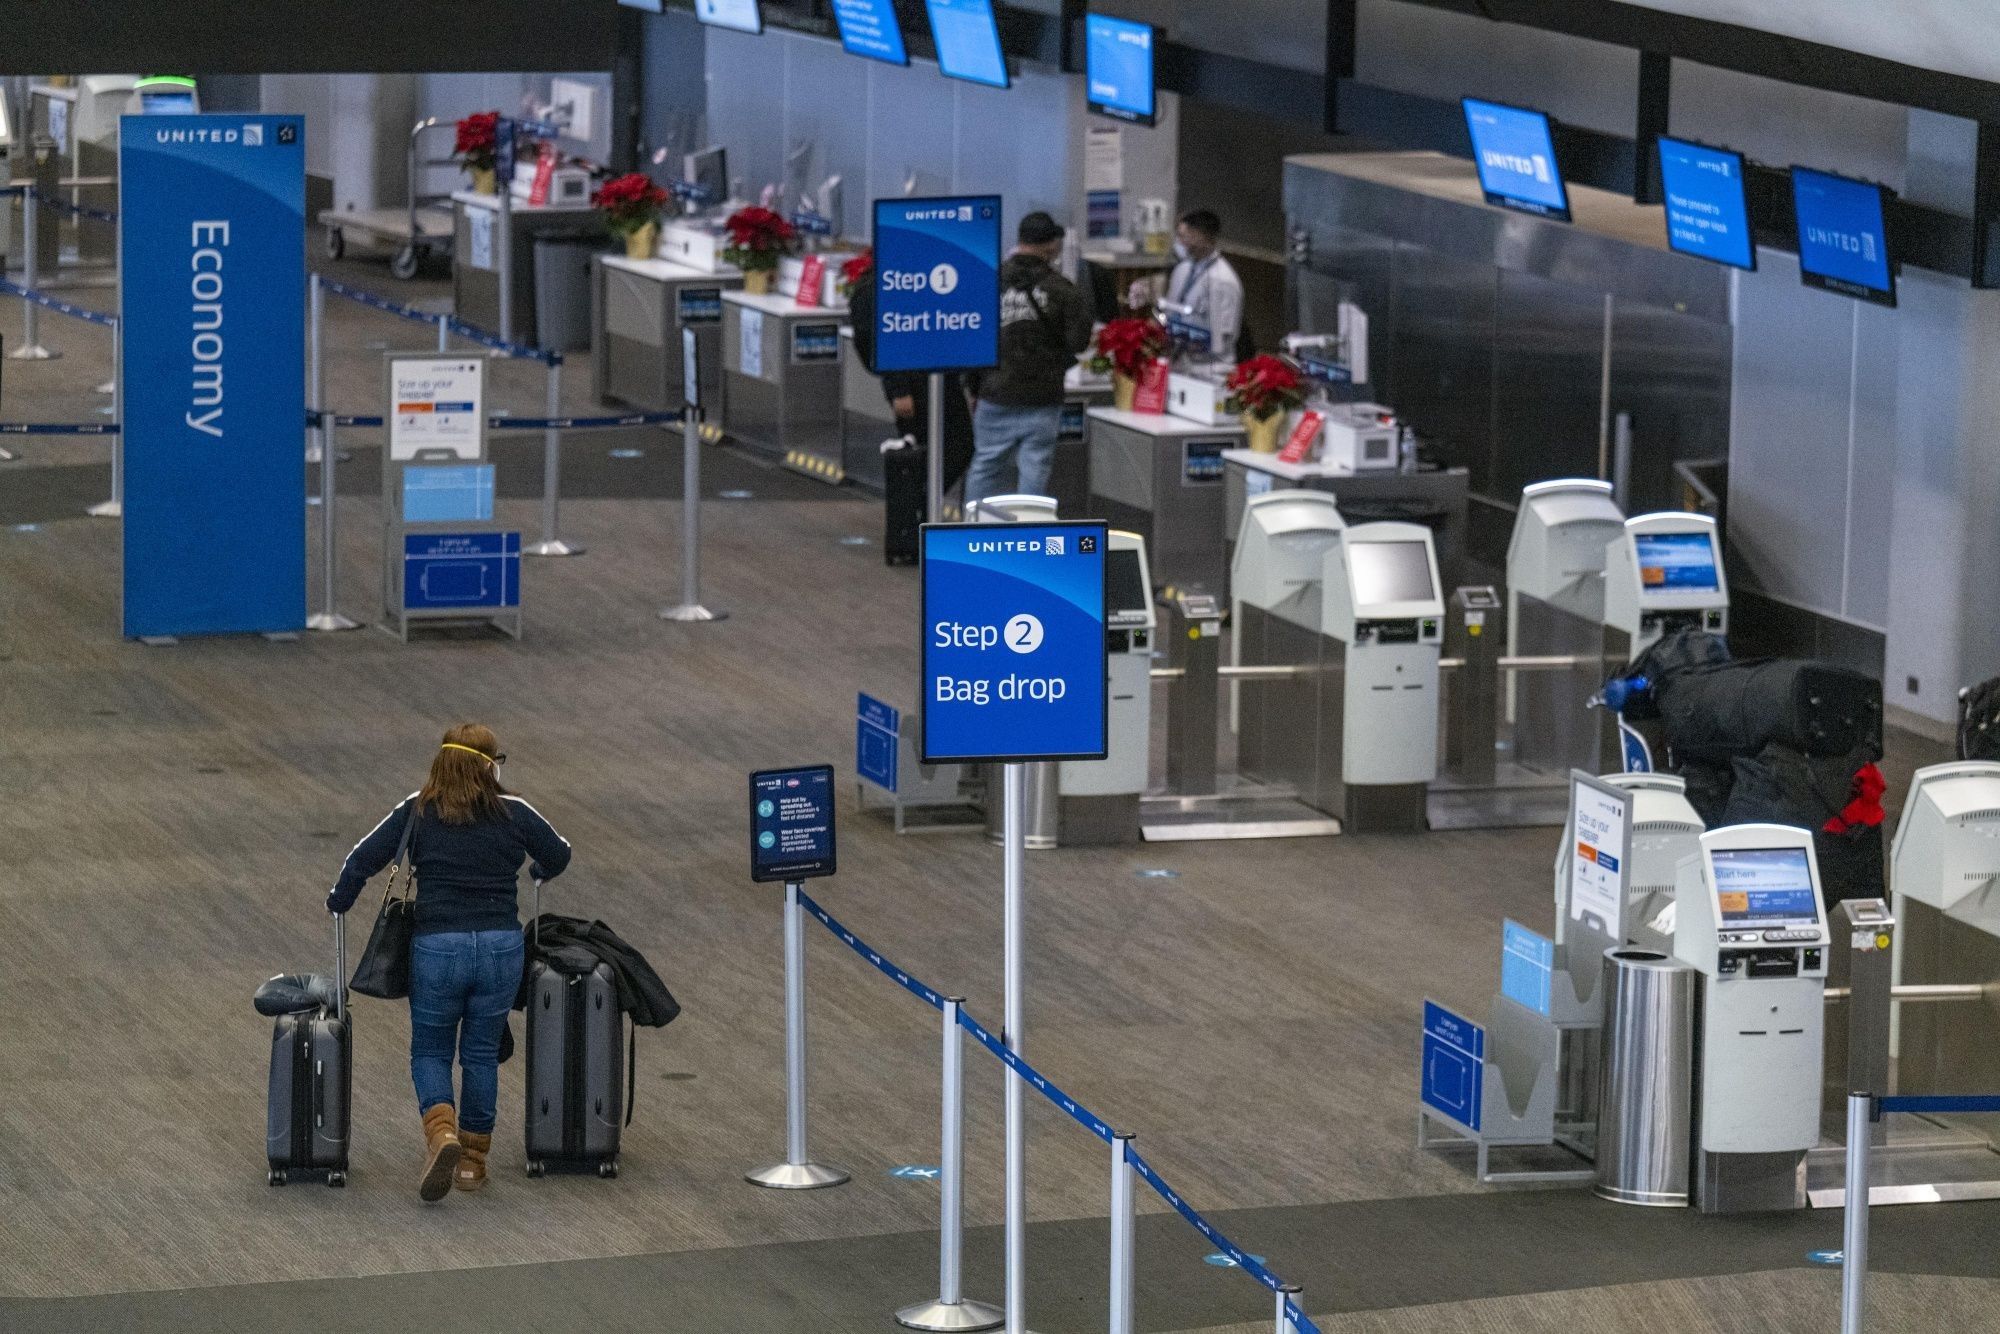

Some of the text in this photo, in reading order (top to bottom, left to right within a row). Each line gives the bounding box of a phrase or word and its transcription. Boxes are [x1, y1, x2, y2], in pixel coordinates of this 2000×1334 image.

[156, 128, 239, 143] UNITED
[1482, 148, 1535, 177] UNITED
[905, 209, 957, 221] UNITED
[1807, 226, 1859, 253] UNITED
[882, 269, 950, 293] Step 1
[185, 220, 230, 438] Economy
[882, 309, 982, 333] Start here
[968, 541, 1041, 553] UNITED
[935, 620, 1032, 651] Step 2
[936, 673, 1066, 705] Bag drop
[1715, 870, 1756, 880] Start here
